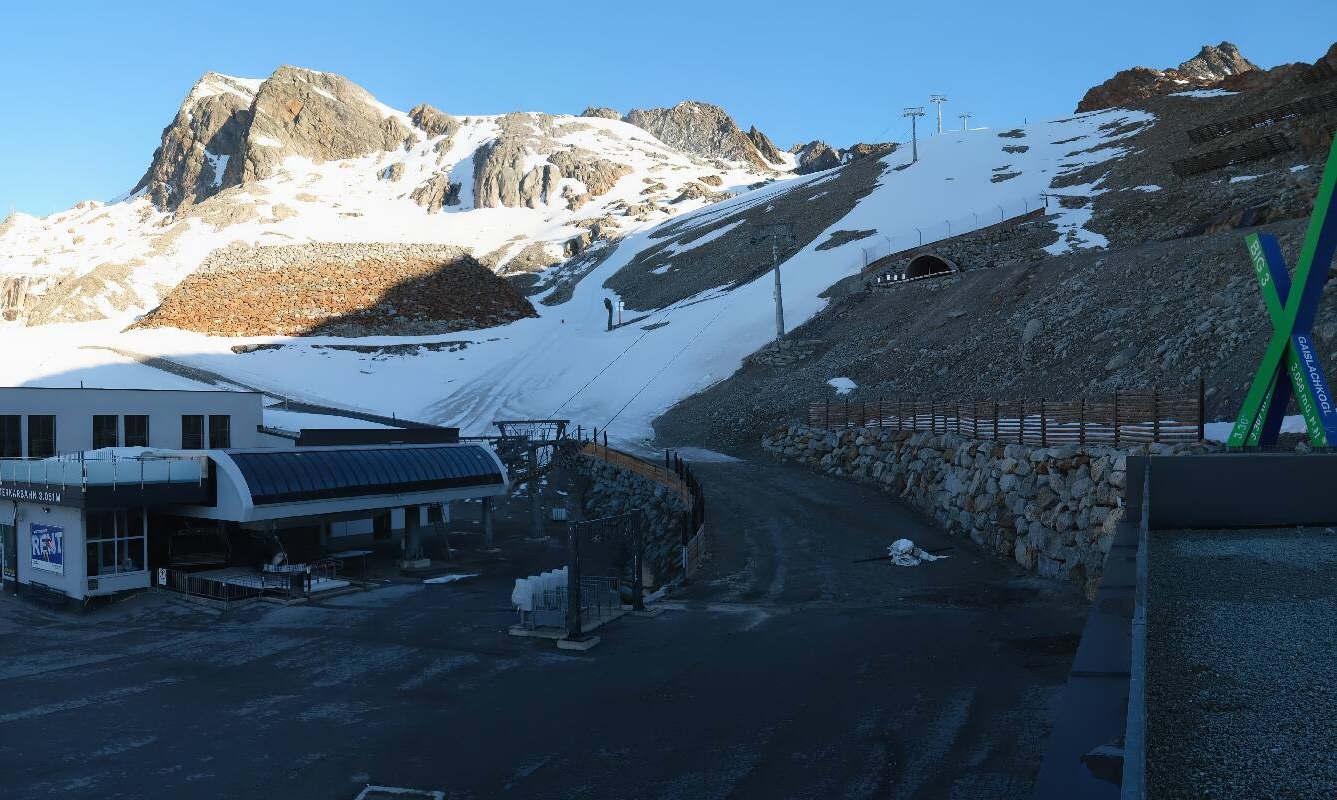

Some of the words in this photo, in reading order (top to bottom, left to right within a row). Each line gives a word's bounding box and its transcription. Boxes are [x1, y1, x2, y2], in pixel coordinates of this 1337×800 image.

[1250, 240, 1265, 273] BIG
[1261, 273, 1270, 287] 3
[1298, 336, 1332, 416] GAISLACHKOGL
[1233, 415, 1249, 440] 3.30
[31, 531, 63, 556] RENT
